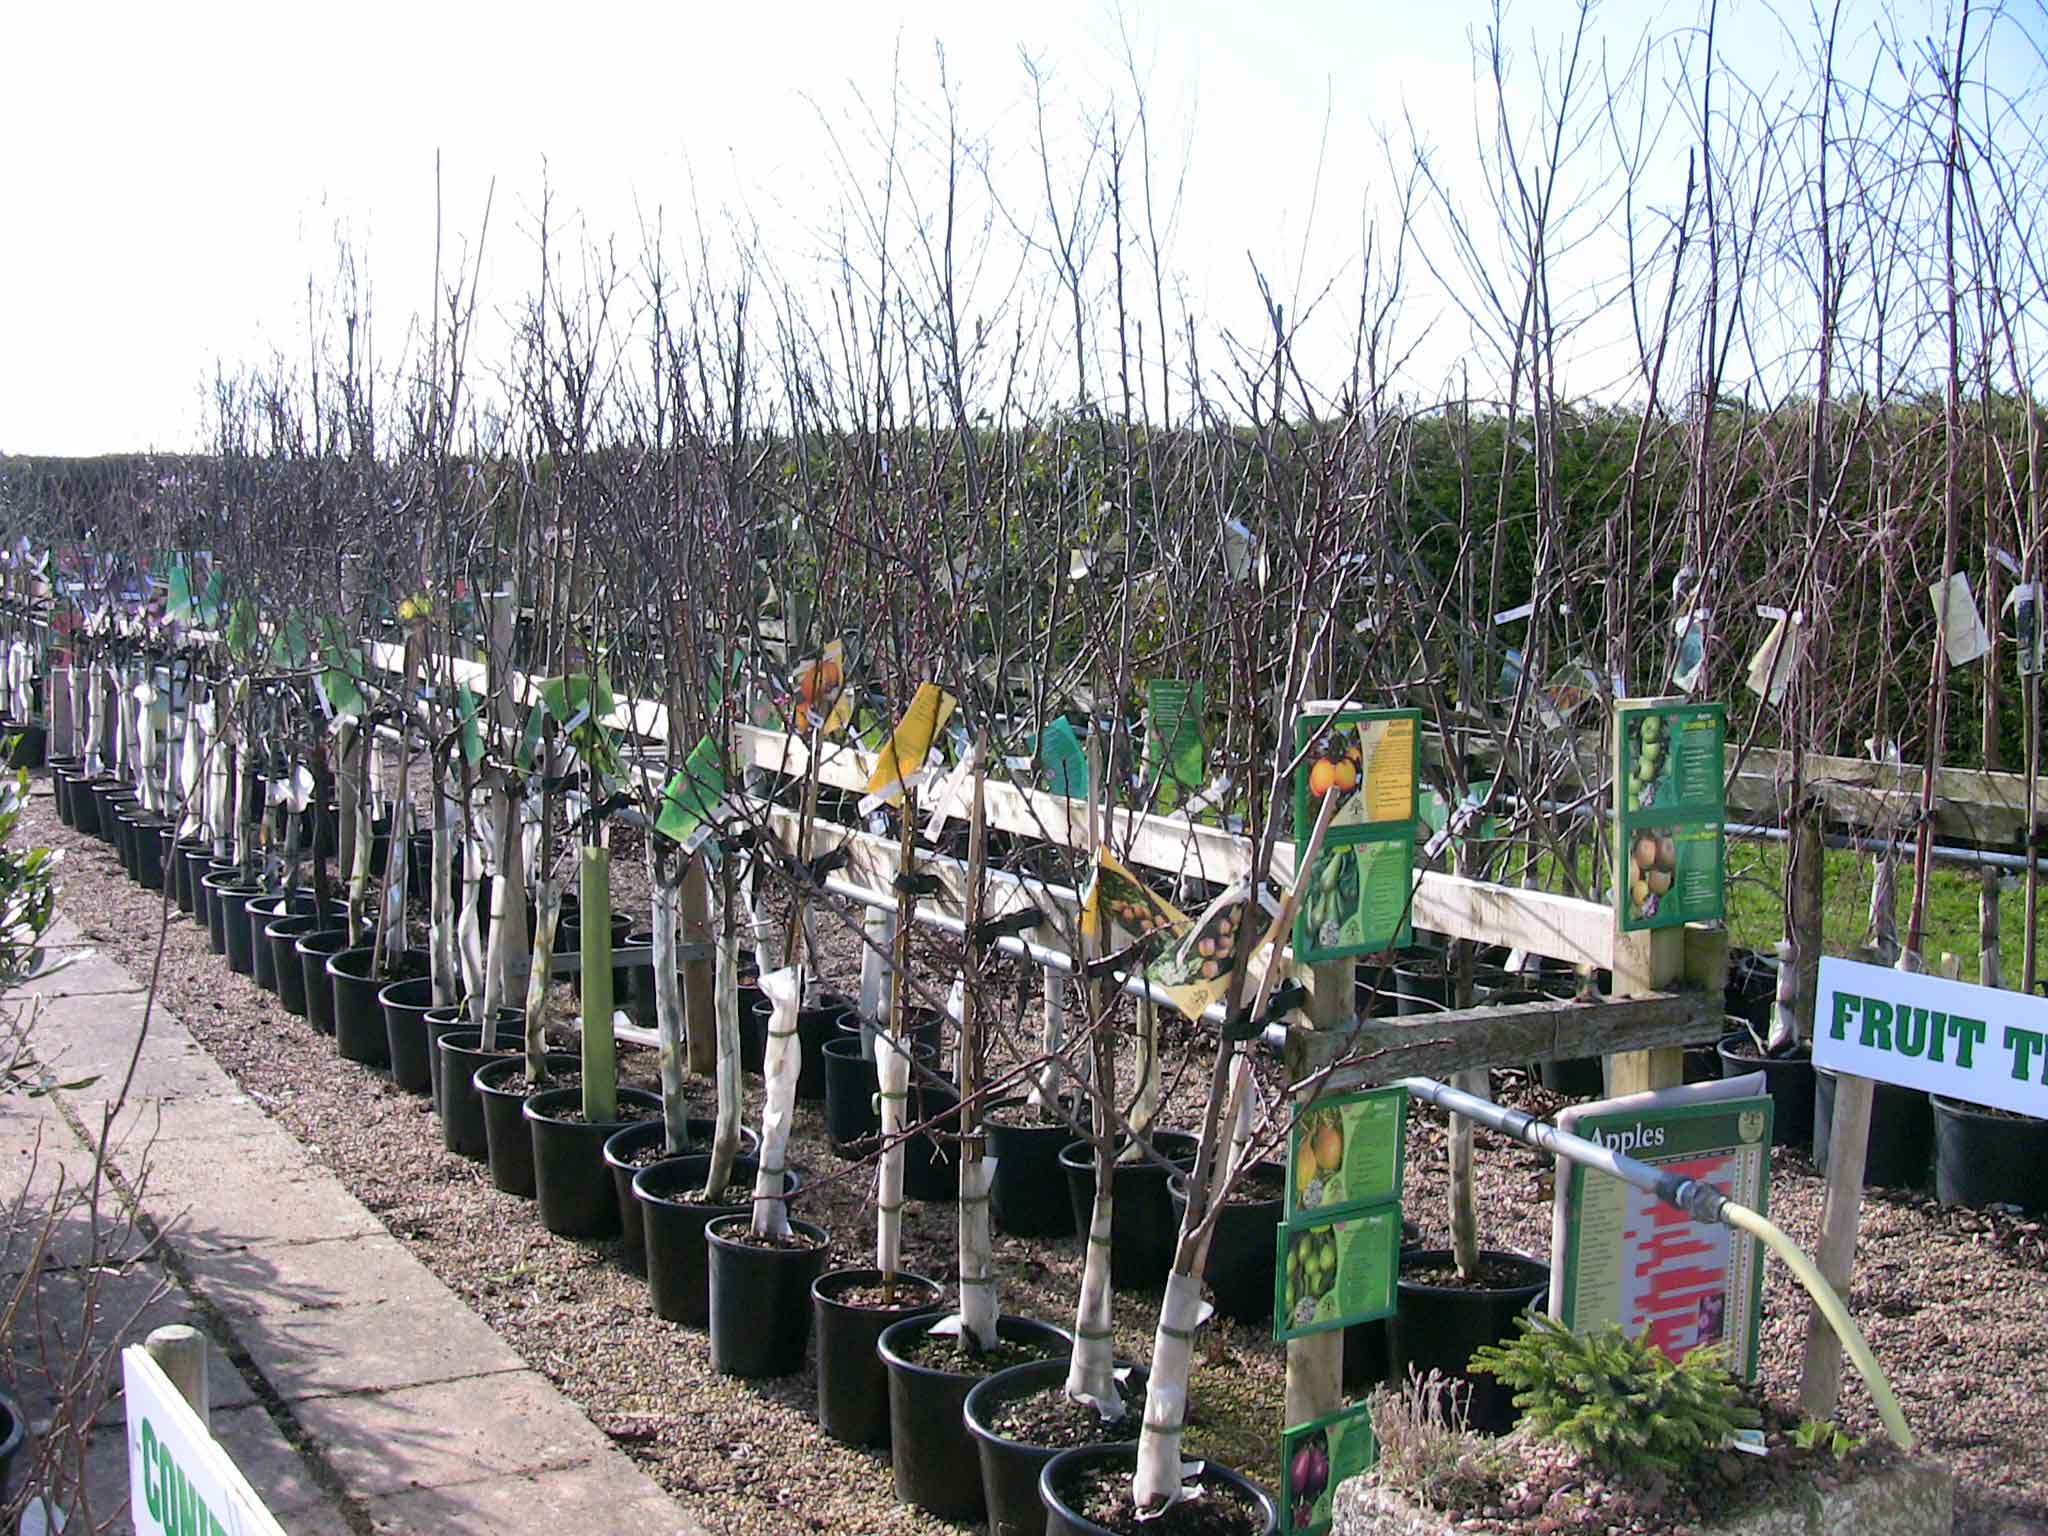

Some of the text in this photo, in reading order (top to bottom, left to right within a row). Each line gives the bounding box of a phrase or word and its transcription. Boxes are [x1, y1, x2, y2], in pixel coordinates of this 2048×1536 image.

[1829, 990, 2048, 1086] FRUIT T
[1590, 1120, 1665, 1156] Apples
